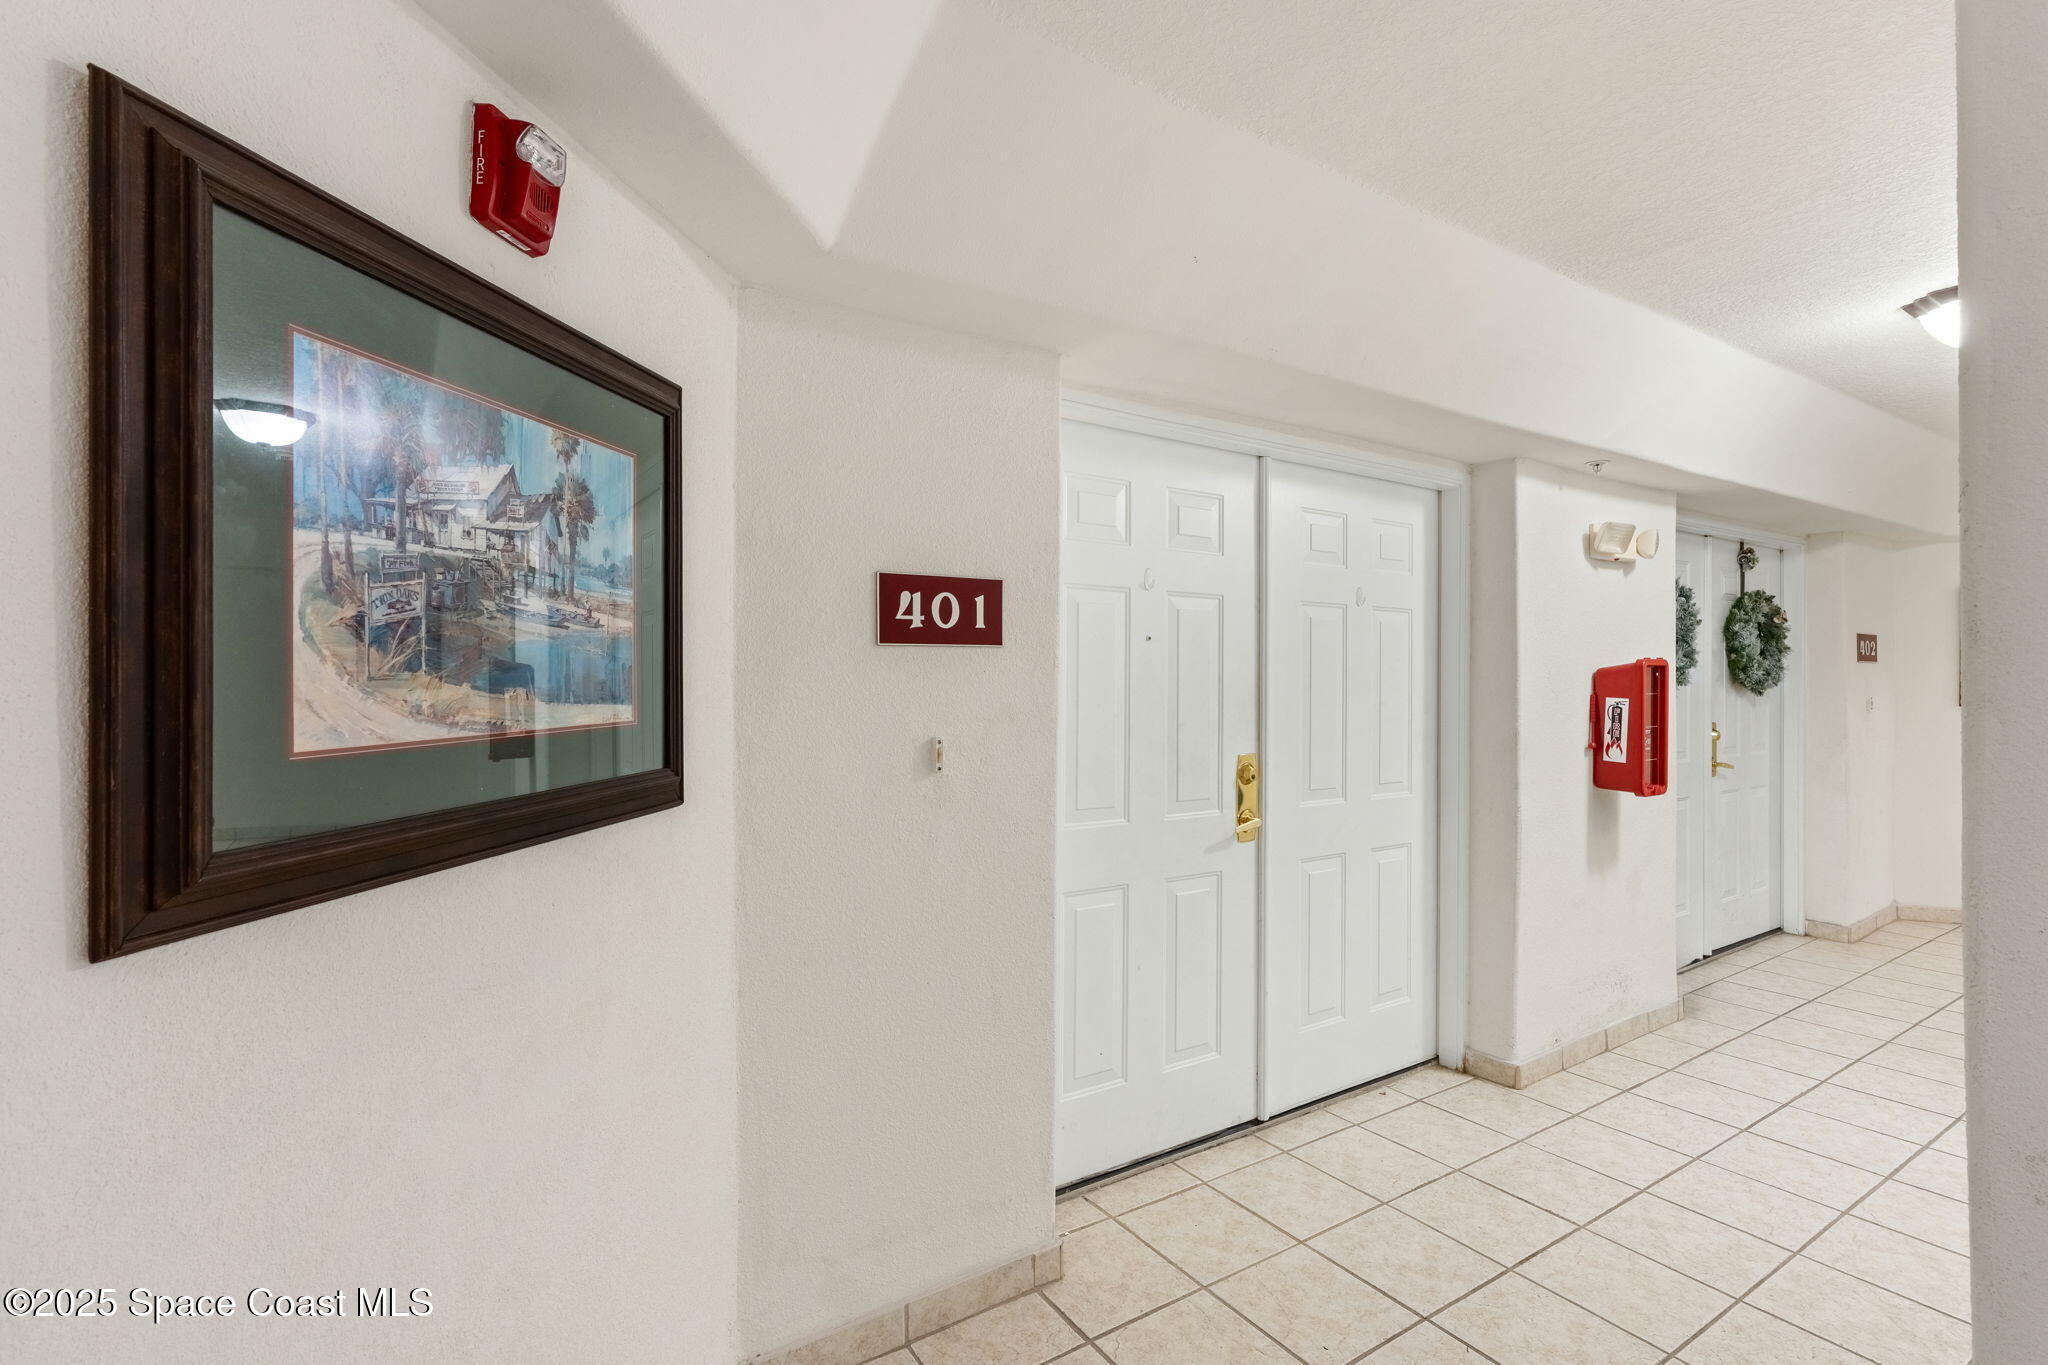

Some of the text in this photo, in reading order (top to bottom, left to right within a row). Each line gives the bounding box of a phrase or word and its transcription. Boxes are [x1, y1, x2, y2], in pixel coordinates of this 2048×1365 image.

[476, 130, 485, 184] FIRE
[895, 590, 986, 629] 401
[1860, 640, 1876, 656] 402
[1612, 708, 1621, 738] FIRE
